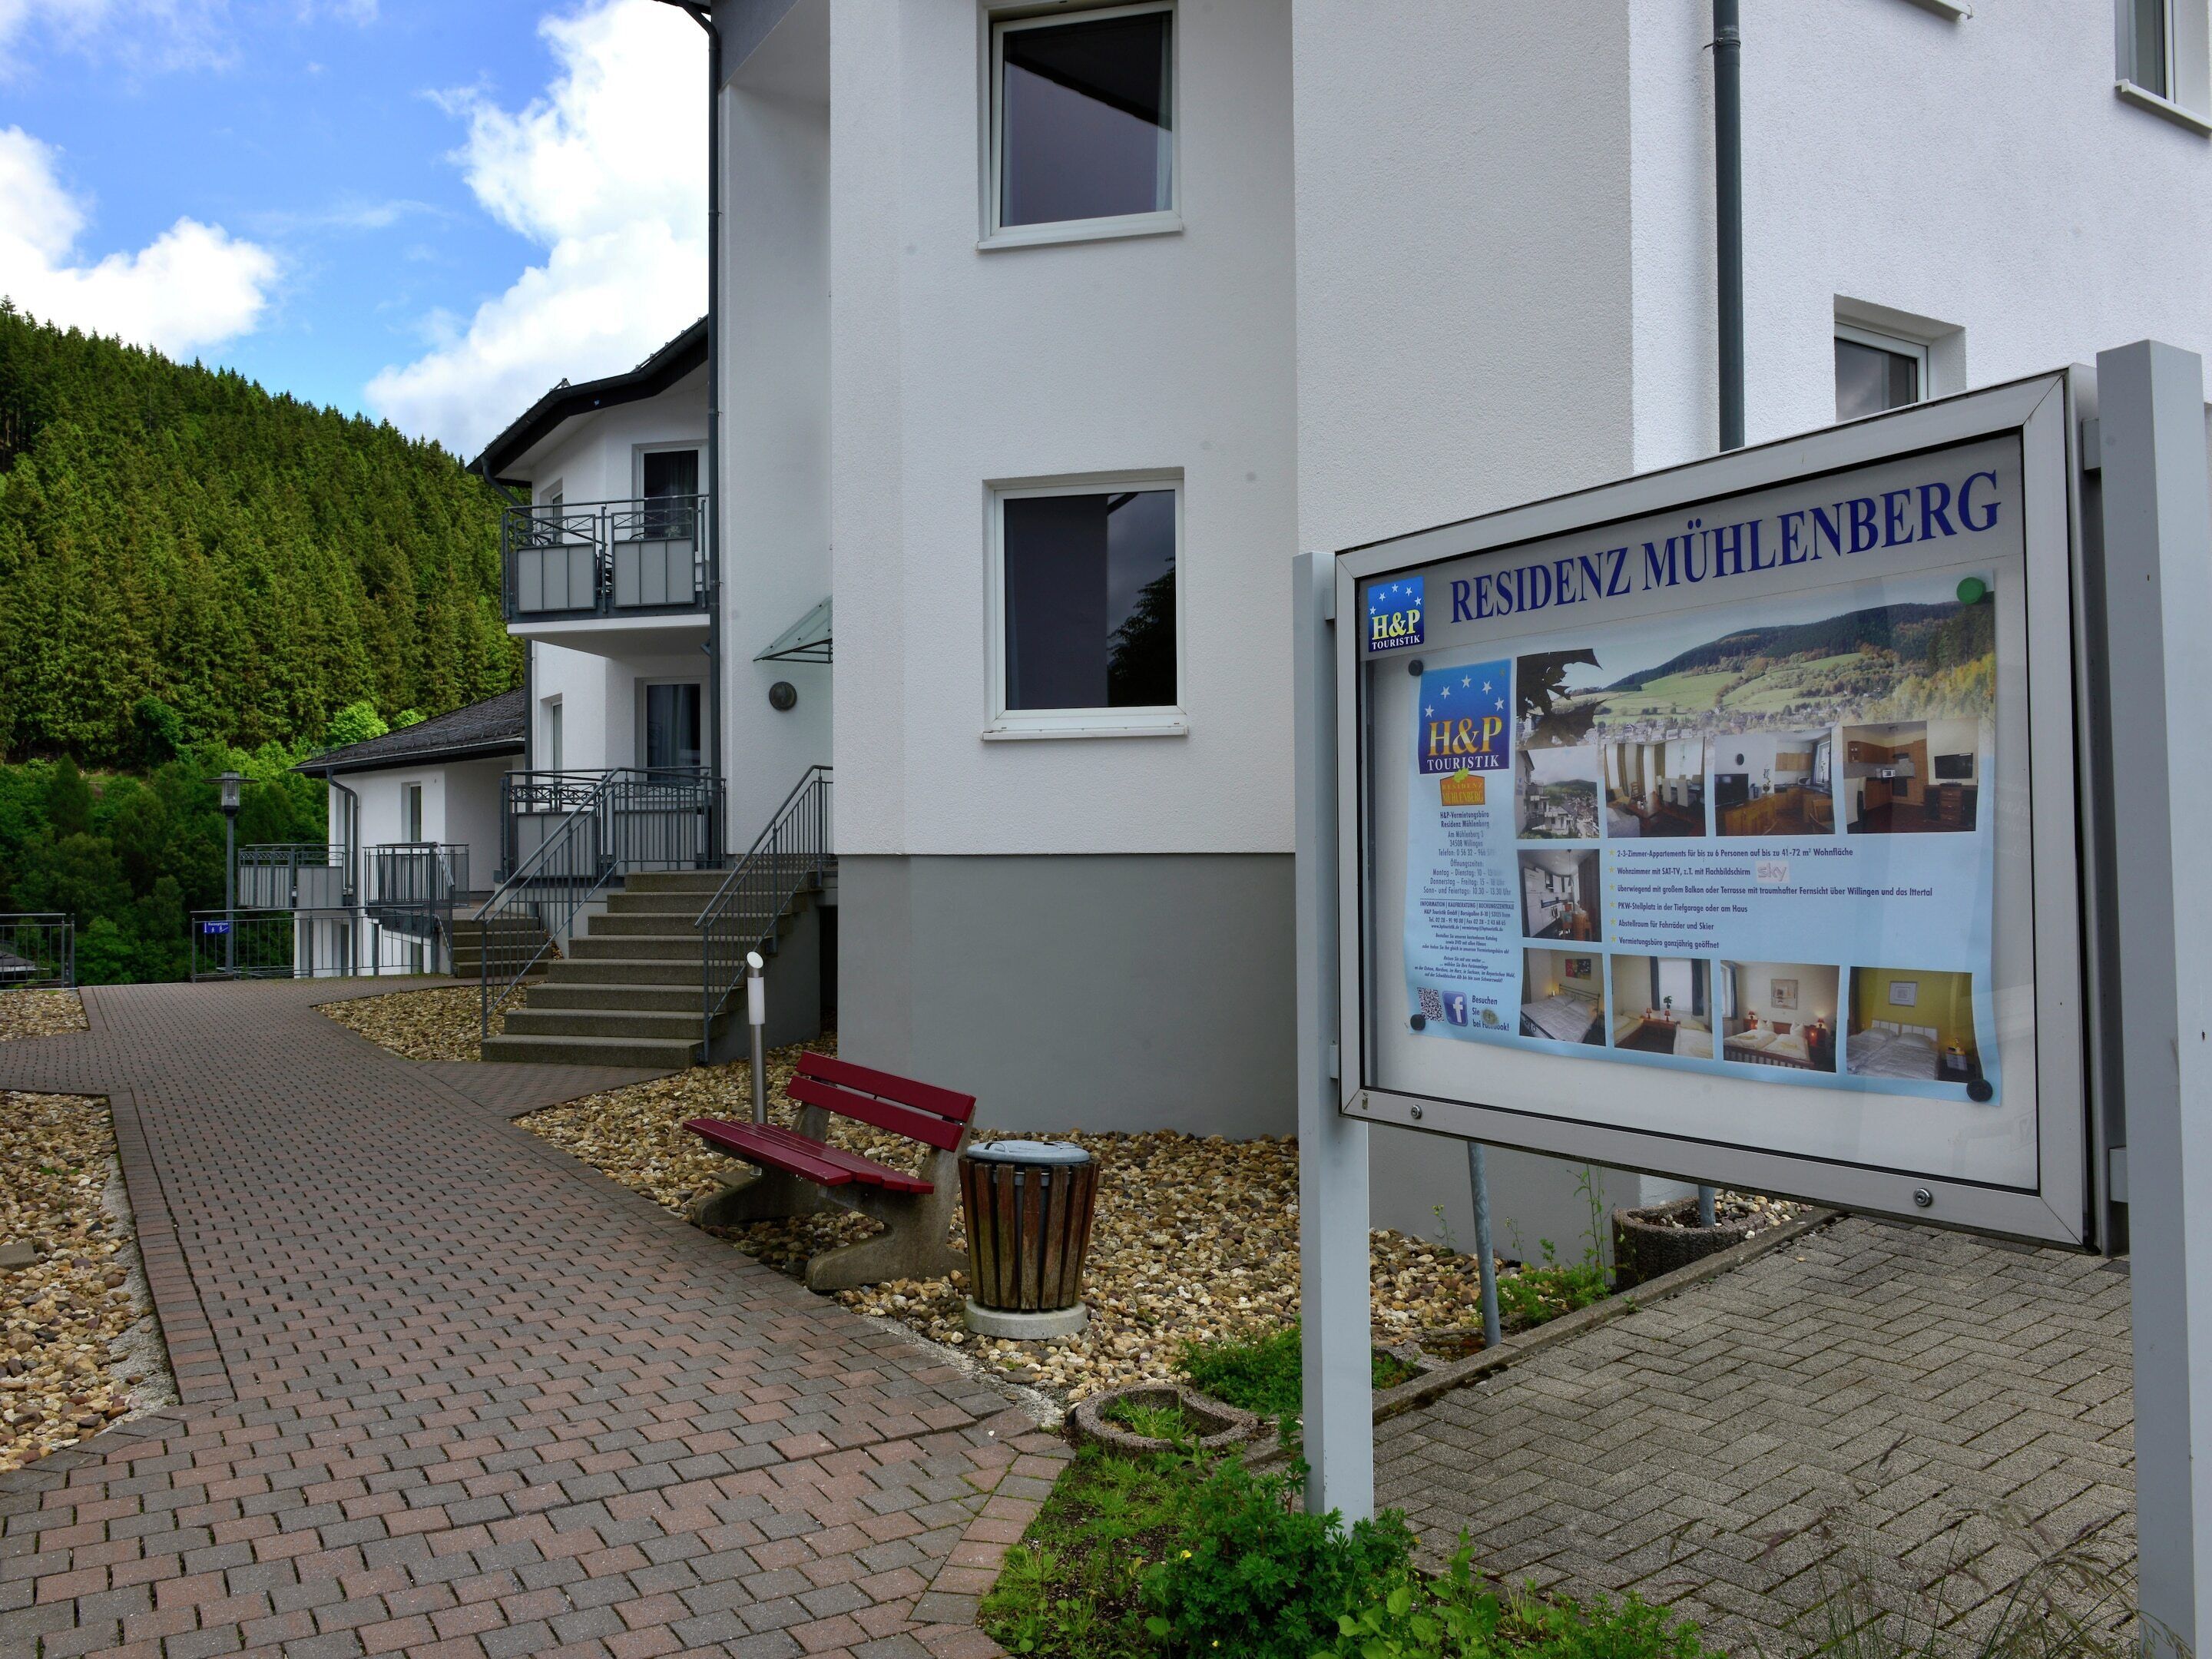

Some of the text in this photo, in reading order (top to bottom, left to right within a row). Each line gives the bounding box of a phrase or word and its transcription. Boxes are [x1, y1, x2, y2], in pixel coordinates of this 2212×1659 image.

[1449, 469, 2002, 624] RESIDENZ MÜHLENBERG
[1372, 609, 1420, 640] H&P
[1372, 635, 1420, 650] TOURISTIK
[1428, 716, 1502, 757] H&P
[1427, 755, 1499, 771] TOURISTIK
[1440, 810, 1489, 820] H&P-Vermietungsbüro
[1462, 820, 1489, 829] Mühlenberg
[1618, 849, 1686, 859] 2-3-Zimmer-Appartements
[1813, 848, 1853, 856] Wohnfläche
[1455, 869, 1475, 877] Dienstag:
[1706, 867, 1750, 876] Flachbildschirm
[1757, 863, 1786, 882] sky
[1430, 877, 1455, 886] Donnerstag
[1618, 885, 1651, 894] überwiegend
[1663, 886, 1683, 894] großem
[1847, 887, 1879, 897] Willingen
[1909, 888, 1932, 896] Ittertal
[1618, 902, 1655, 911] PKW-Stellplatz
[1674, 904, 1704, 913] Tiefgarage
[1619, 936, 1719, 949] Vermietungsbüro ganzjährig geöffnet
[1472, 995, 1497, 1005] Besuchen
